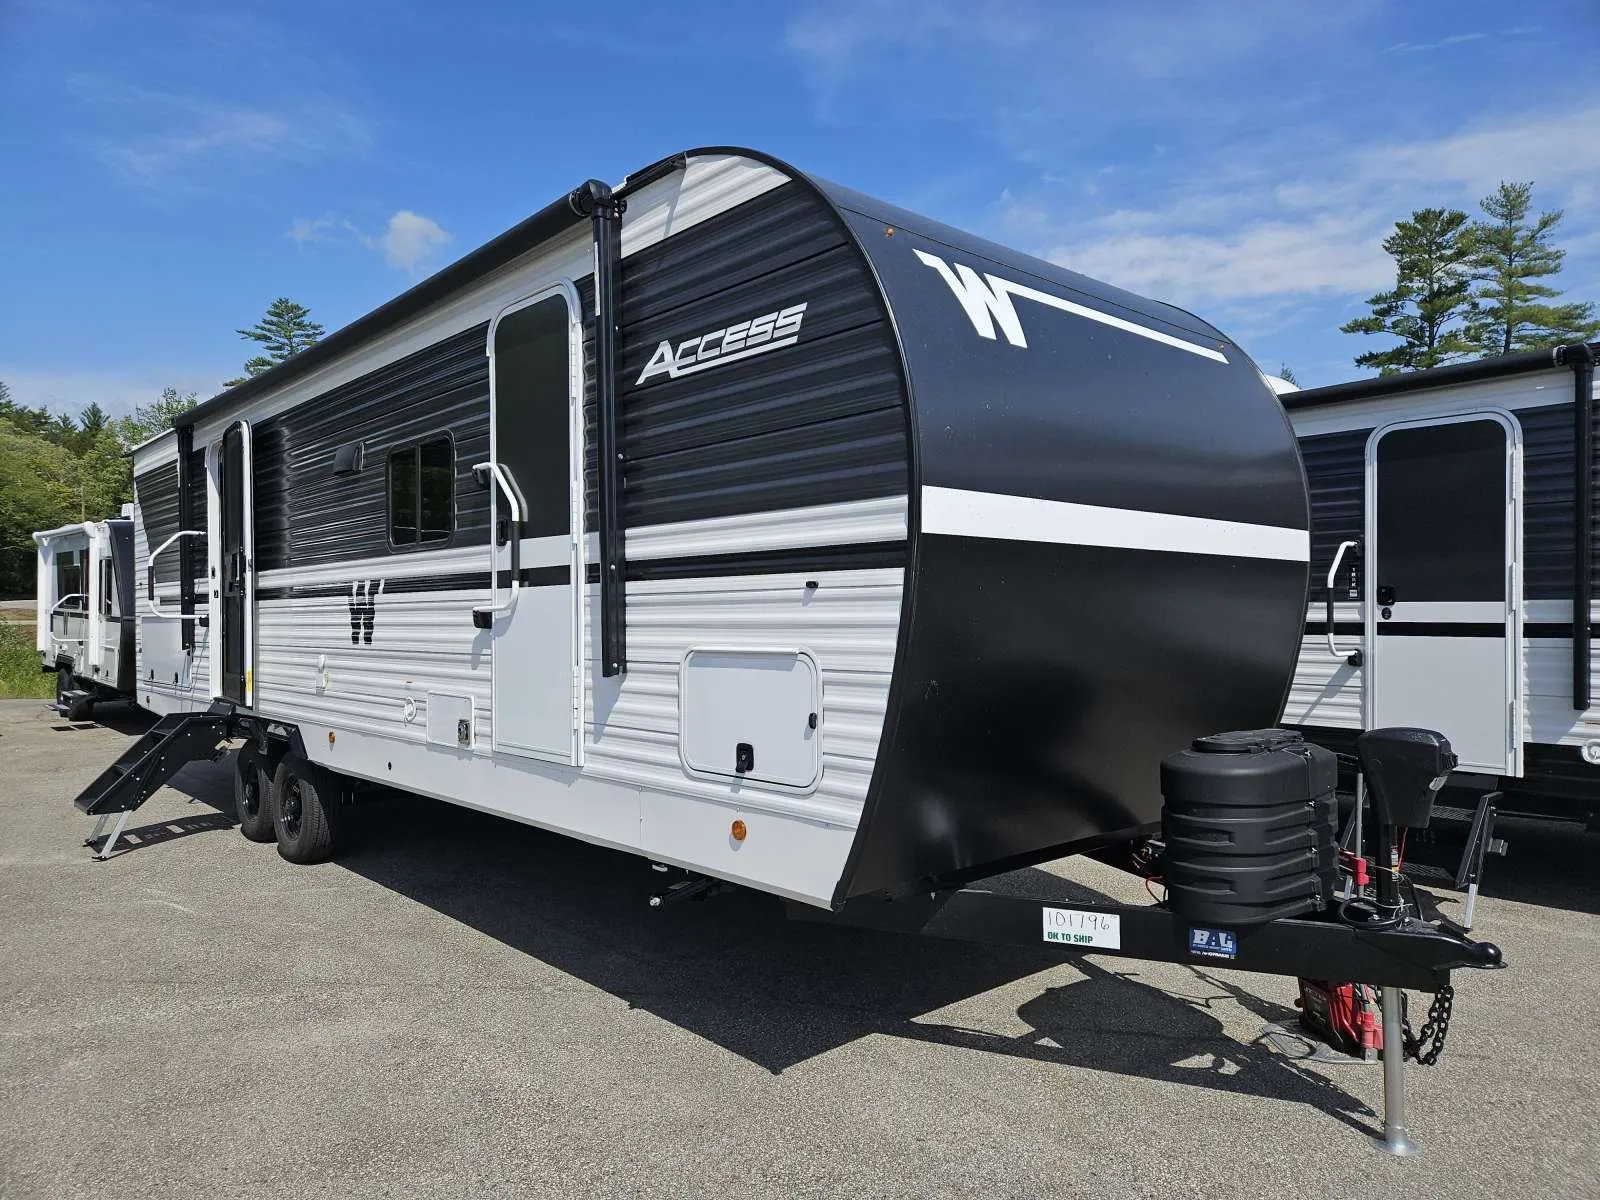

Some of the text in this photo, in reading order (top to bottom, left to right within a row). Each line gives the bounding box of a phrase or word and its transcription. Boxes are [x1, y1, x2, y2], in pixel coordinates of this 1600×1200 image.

[634, 301, 808, 386] ACCESS
[1048, 911, 1110, 931] 101796
[1047, 931, 1094, 944] OK TO SHIP
